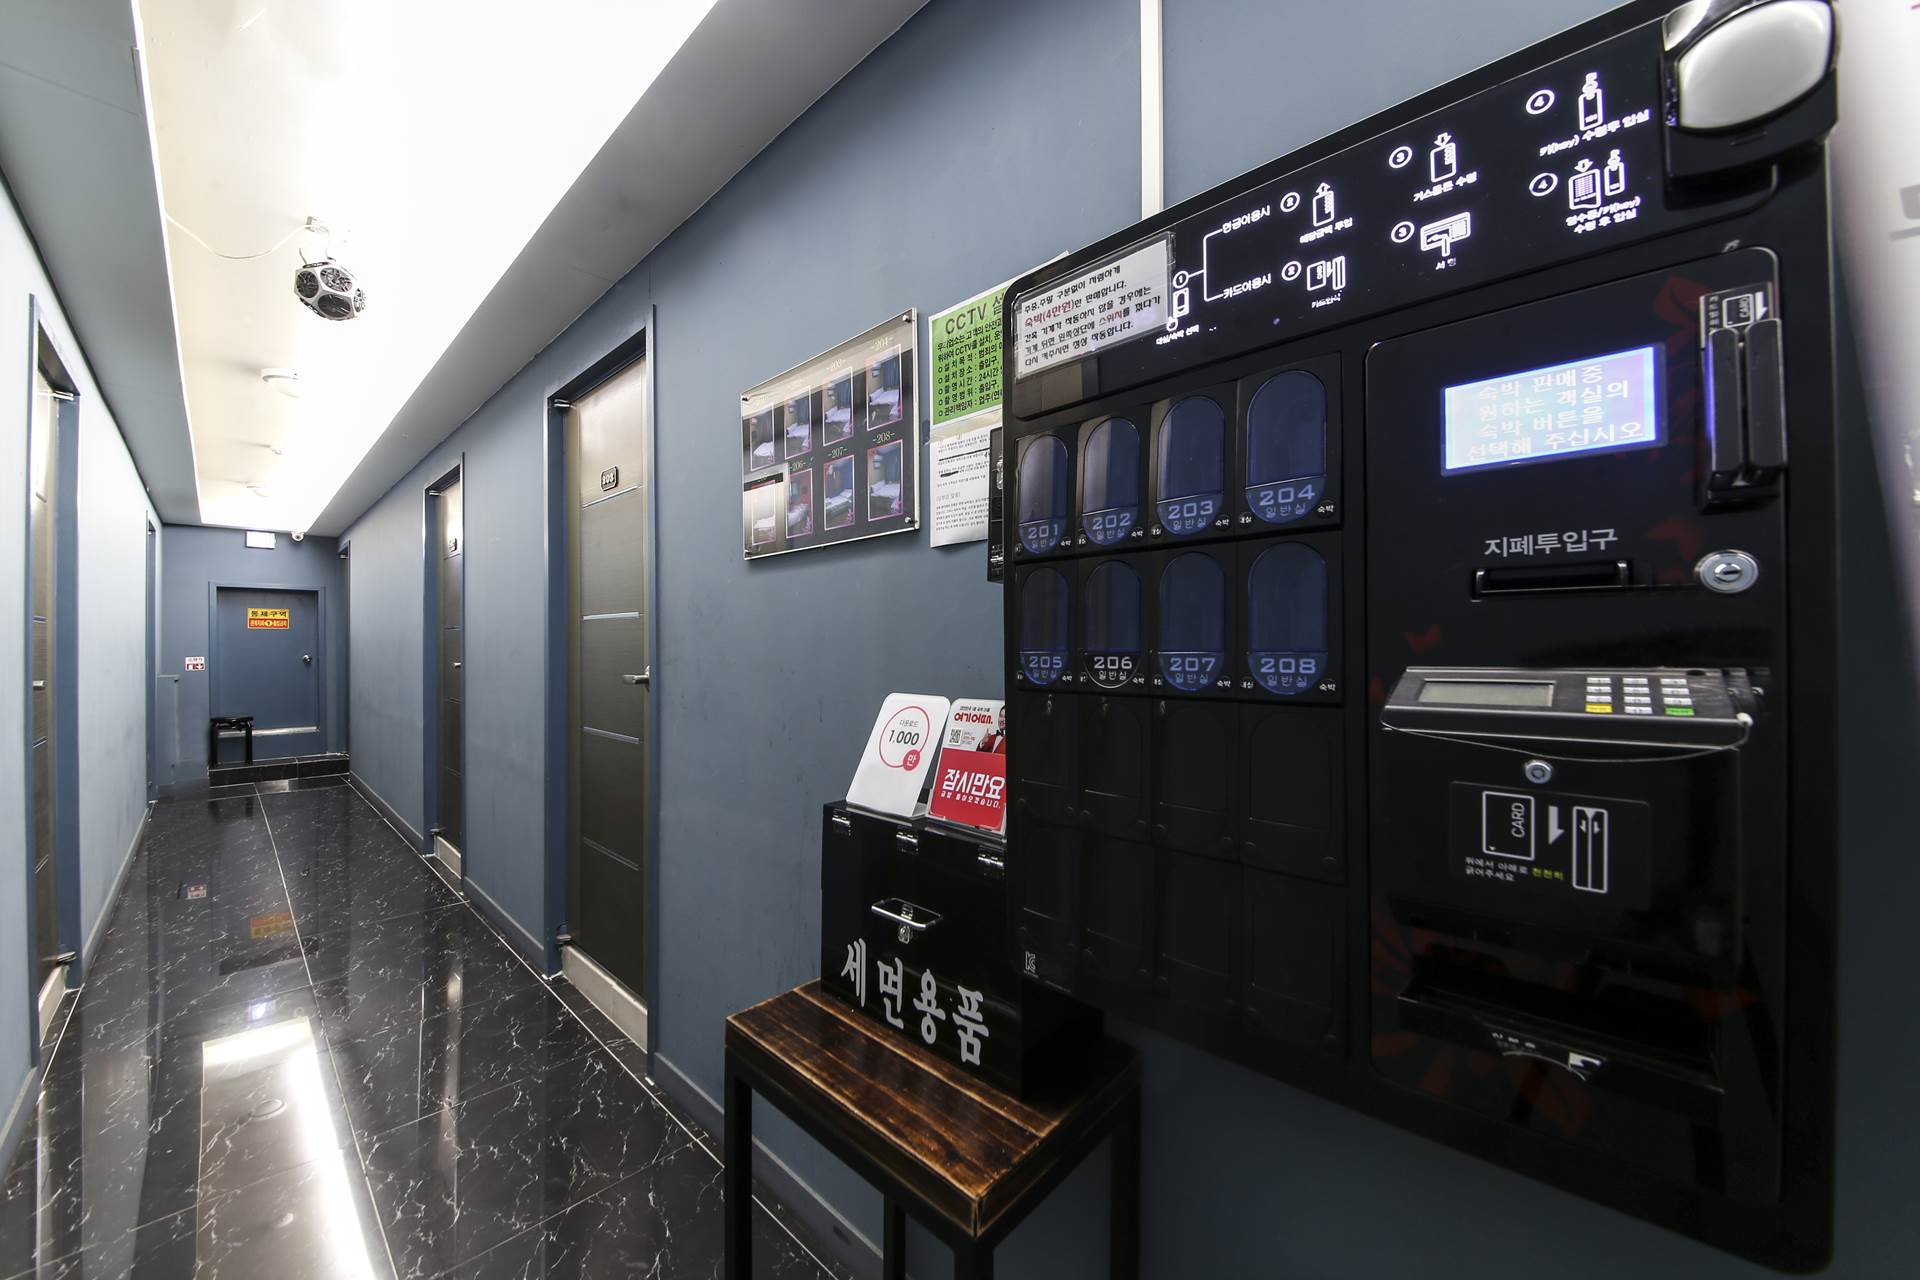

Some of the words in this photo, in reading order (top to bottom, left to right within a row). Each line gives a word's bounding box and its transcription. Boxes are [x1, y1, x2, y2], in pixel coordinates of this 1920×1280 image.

[1222, 205, 1271, 233] 현금이용시
[1057, 282, 1086, 299] 구분없이
[1089, 265, 1121, 284] 저렴하게
[1223, 273, 1271, 299] 카드이용시
[1025, 299, 1082, 327] 숙박(4만원)만
[1085, 280, 1127, 304] 판매합니다.
[1041, 321, 1062, 335] 기계가
[1065, 309, 1095, 325] 작동하지
[1098, 300, 1114, 314] 않을
[1119, 286, 1151, 305] 경우에는
[945, 303, 987, 335] CCTV
[1025, 344, 1038, 354] 기계
[1099, 307, 1130, 325] 스위치를
[1135, 296, 1161, 312] 껐다가
[967, 326, 984, 339] 고객의
[955, 341, 978, 357] CCTV를
[978, 344, 997, 358] 범죄의
[1025, 354, 1038, 366] 다시
[1091, 321, 1133, 342] 작동합니다.
[978, 367, 999, 382] 24시간
[1480, 380, 1520, 401] 숙박
[1532, 365, 1603, 393] 판매중
[1479, 398, 1544, 421] 원하는
[1556, 380, 1629, 406] 객실의
[1479, 420, 1521, 439] 숙박
[1533, 405, 1604, 432] 버튼을
[1467, 437, 1532, 461] 선택해
[1545, 421, 1644, 450] 주십시오
[1260, 484, 1315, 506] 204
[1168, 501, 1213, 520] 203
[1266, 503, 1306, 518] 일반실
[1317, 504, 1334, 513] 숙박
[1028, 524, 1058, 539] 201
[1093, 513, 1131, 530] 202
[1173, 518, 1207, 531] 일반실
[1215, 518, 1230, 527] 숙박
[1097, 529, 1125, 541] 일반실
[1484, 528, 1618, 558] 지폐투입구
[1029, 656, 1063, 668] 205
[1094, 656, 1132, 669] 206
[1170, 658, 1216, 672] 207
[1260, 658, 1316, 674] 208
[1099, 670, 1127, 681] 일반실
[1175, 673, 1208, 684] 일반실
[1217, 680, 1231, 688] 숙박
[1267, 674, 1307, 687] 일반실
[1319, 683, 1336, 691] 숙박
[942, 768, 1005, 800] 잠시만요
[1511, 803, 1525, 838] CARD
[841, 938, 989, 1066] 세면용품
